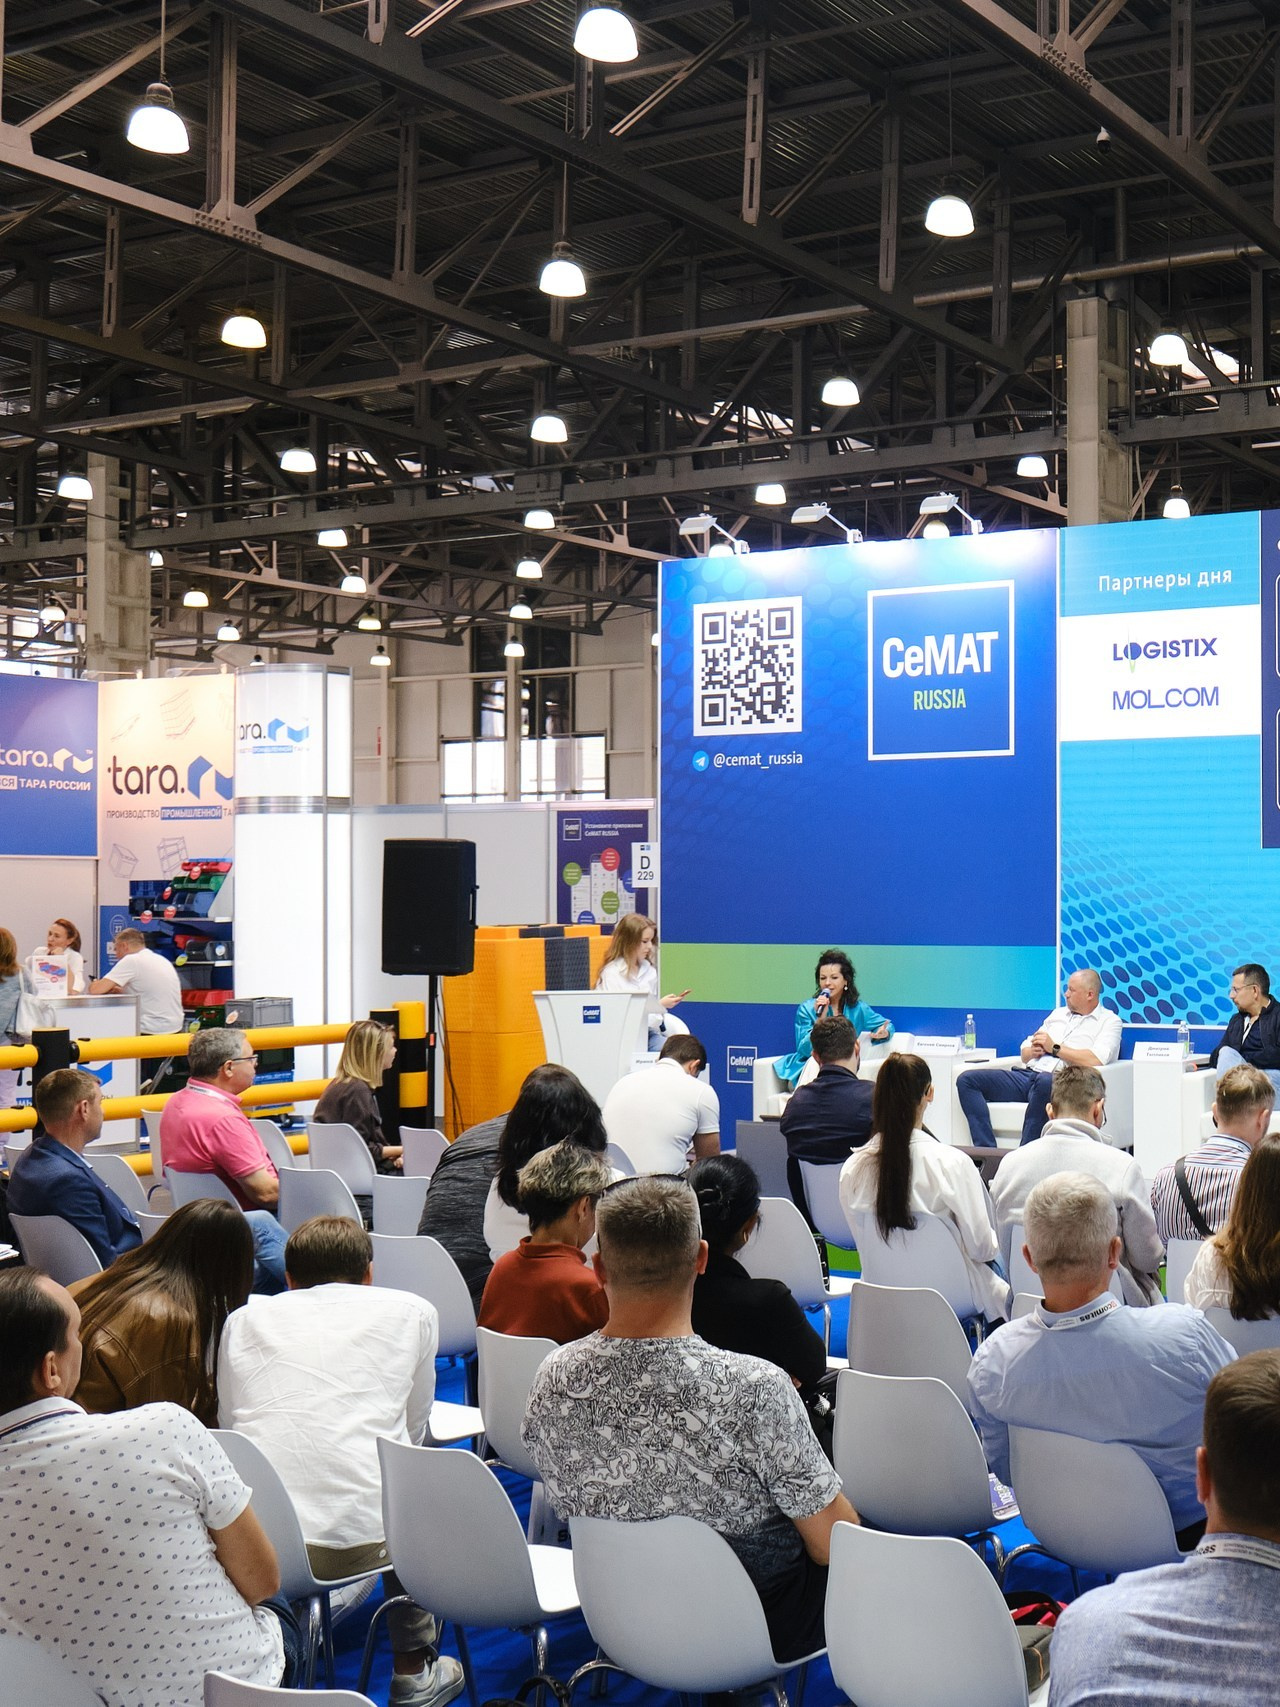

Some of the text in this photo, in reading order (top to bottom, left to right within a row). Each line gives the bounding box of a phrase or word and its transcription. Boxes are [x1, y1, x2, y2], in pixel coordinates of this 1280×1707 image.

[1099, 569, 1232, 595] Партнеры дня
[882, 631, 999, 678] CeMAT
[1113, 638, 1218, 661] LOGISTIX
[913, 688, 967, 711] RUSSIA
[713, 751, 803, 770] @cemat_russia
[19, 778, 47, 789] ТАРА
[49, 780, 91, 791] РОССИИ
[641, 856, 651, 870] D
[637, 871, 654, 881] 229
[730, 1056, 754, 1066] CeMAT
